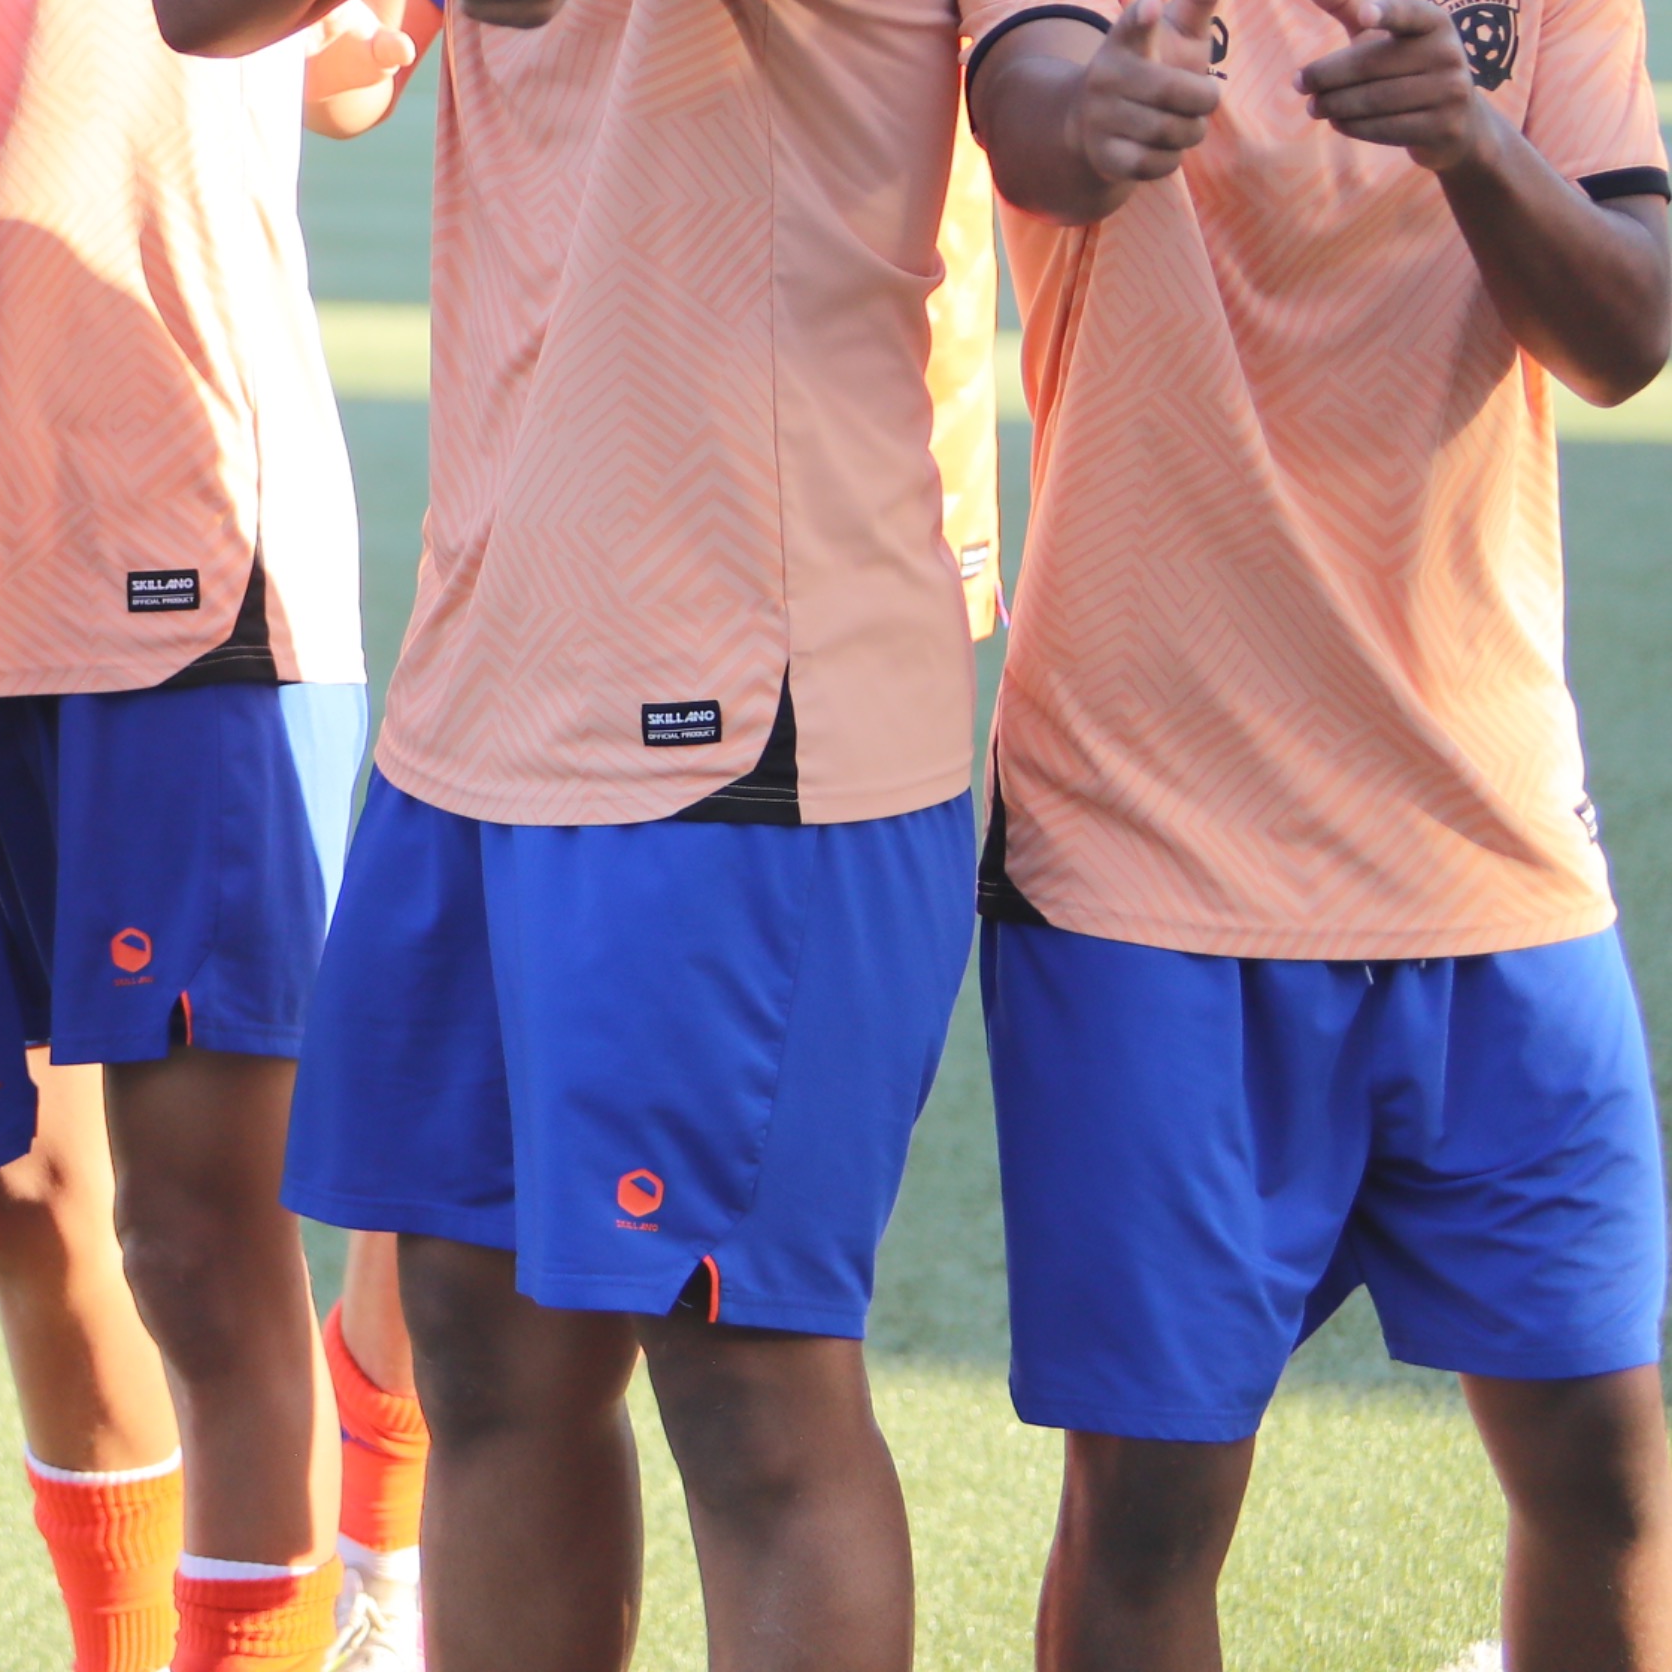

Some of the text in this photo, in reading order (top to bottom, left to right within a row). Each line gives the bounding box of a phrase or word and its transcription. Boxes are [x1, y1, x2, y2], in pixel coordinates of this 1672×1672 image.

[131, 577, 194, 591] SKILLANO
[647, 710, 715, 725] SKILLANO
[681, 729, 716, 739] PRODUCT
